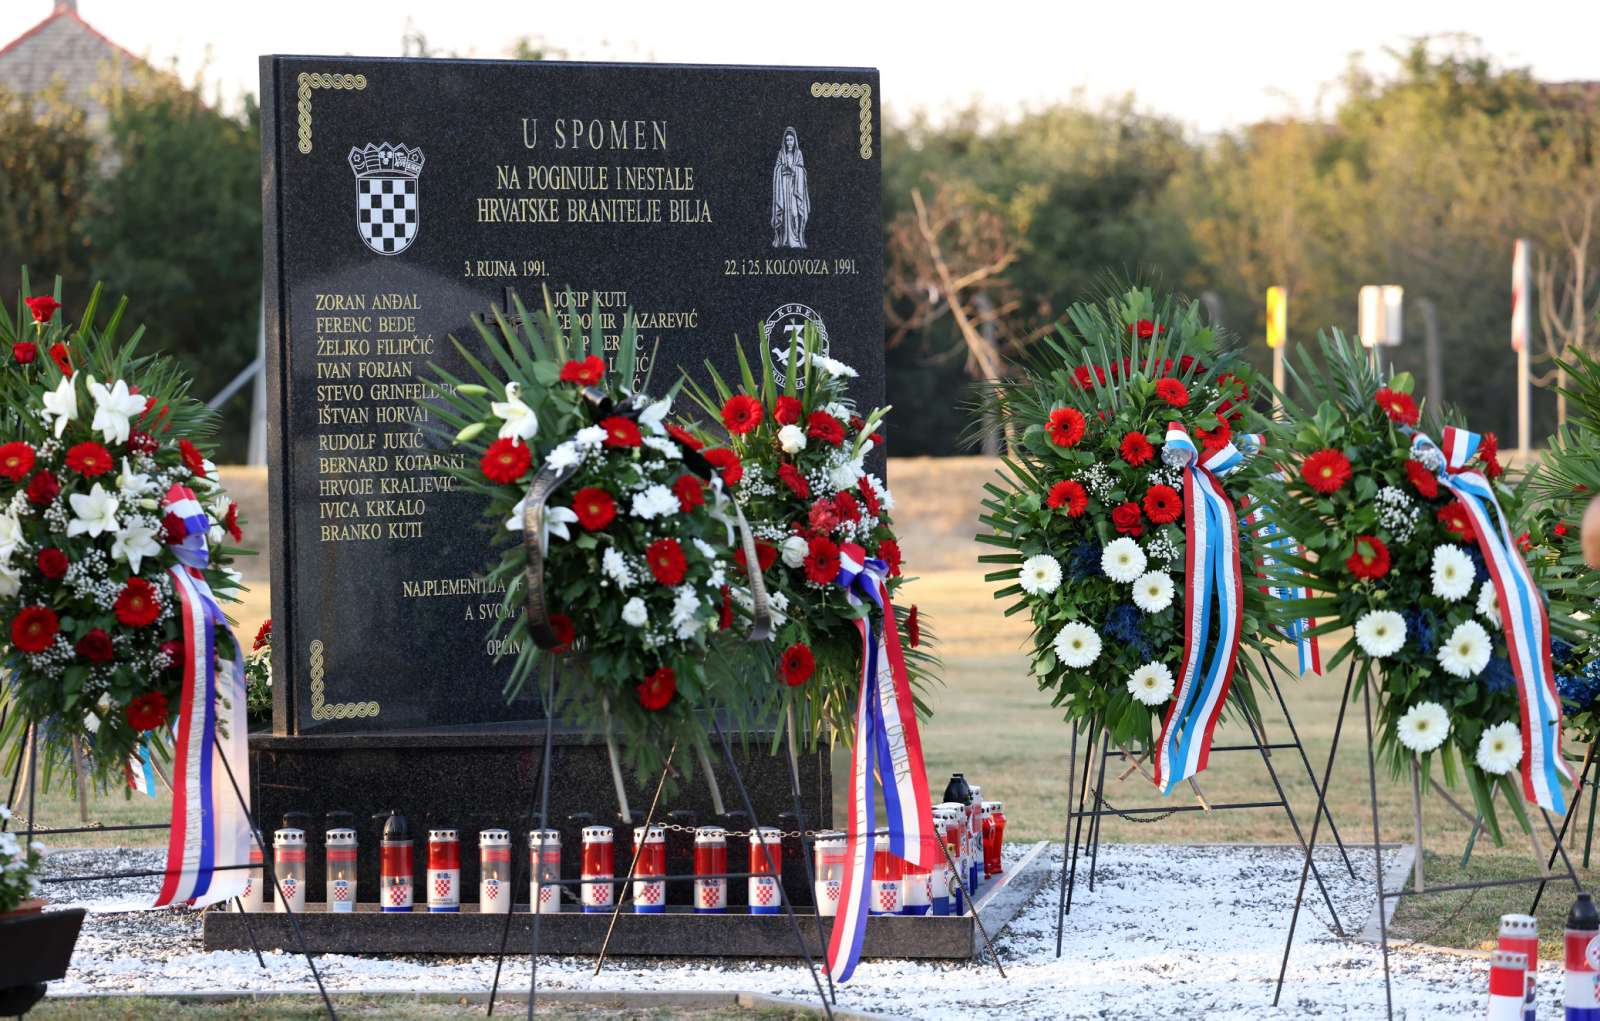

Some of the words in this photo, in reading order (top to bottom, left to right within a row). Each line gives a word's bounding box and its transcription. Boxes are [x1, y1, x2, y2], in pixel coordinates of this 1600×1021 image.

[522, 118, 538, 149] U
[554, 119, 668, 150] SPOMEN
[496, 165, 522, 190] NA
[527, 165, 609, 191] POGINULE
[616, 166, 623, 190] I
[626, 166, 695, 191] NESTALE
[477, 198, 560, 222] HRVATSKE
[567, 199, 662, 223] BRANITELJE
[669, 199, 713, 223] BILJA
[464, 260, 474, 277] 3.
[477, 260, 517, 277] RUJNA
[522, 260, 550, 277] 1991.
[724, 259, 739, 275] 22.
[742, 259, 747, 274] i
[748, 259, 763, 275] 25.
[765, 259, 829, 275] KOLOVOZA
[834, 259, 860, 275] 1991.
[315, 294, 365, 311] ZORAN
[372, 294, 421, 310] ANĐAL
[554, 291, 589, 308] JOSIP
[594, 291, 627, 308] KUTI
[316, 316, 372, 333] FERENC
[379, 316, 416, 333] BEDE
[317, 336, 370, 356] ŽELJKO
[376, 334, 434, 355] FILIPČIĆ
[317, 362, 351, 379] IVAN
[358, 361, 412, 378] FORJAN
[317, 384, 364, 402] STEVO
[318, 404, 369, 425] IŠTVAN
[376, 406, 429, 423] HORVAT
[319, 433, 377, 451] RUDOLF
[383, 428, 424, 449] JUKIĆ
[319, 456, 388, 474] BERNARD
[395, 454, 465, 472] KOTARSKI
[319, 478, 373, 496] HRVOJE
[319, 501, 360, 519] IVICA
[366, 499, 426, 517] KRKALO
[320, 523, 382, 542] BRANKO
[388, 522, 423, 540] KUTI
[465, 604, 474, 621] A
